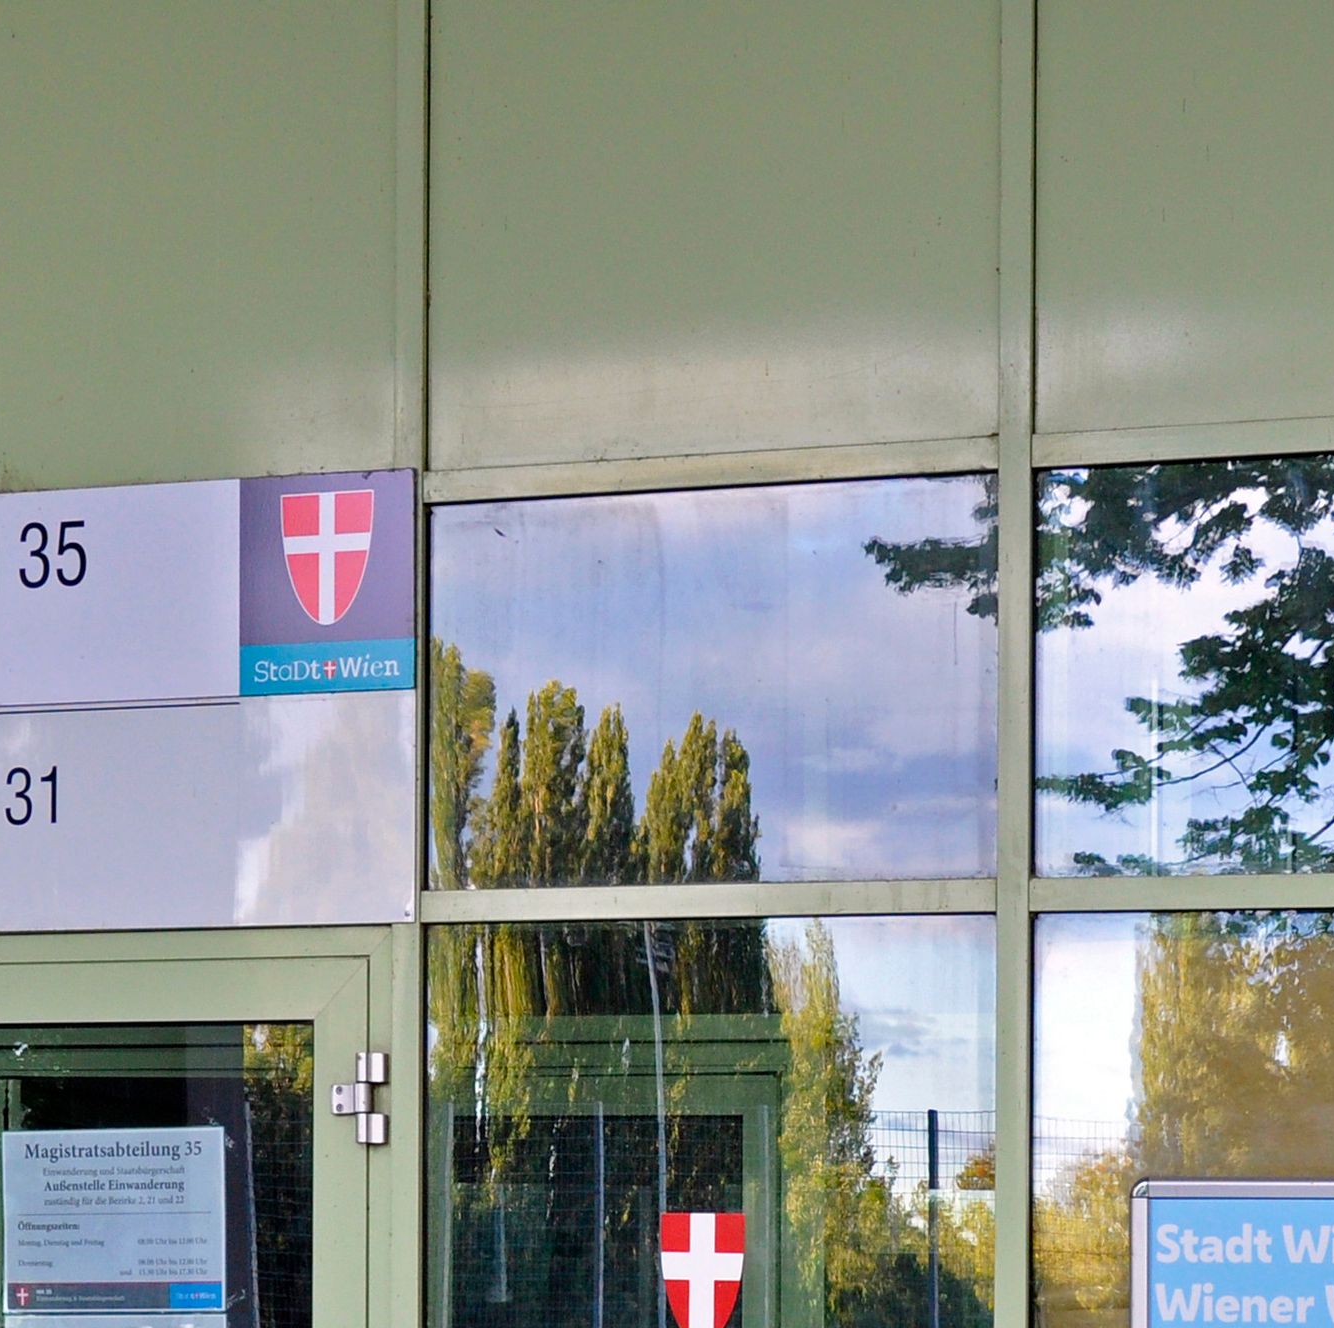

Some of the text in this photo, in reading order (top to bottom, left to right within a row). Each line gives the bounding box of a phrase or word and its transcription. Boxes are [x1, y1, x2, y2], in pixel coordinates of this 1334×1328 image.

[17, 520, 88, 589] 35
[338, 654, 400, 677] Wien
[4, 767, 62, 827] 31
[25, 1141, 202, 1163] Magistratsabteilung 35
[43, 1167, 97, 1177] Einwanderung
[100, 1167, 115, 1175] und
[44, 1180, 184, 1191] Außenstelle Einwanderung
[44, 1197, 80, 1207] zuständig
[82, 1196, 92, 1205] für
[95, 1196, 107, 1205] die
[158, 1196, 173, 1204] und
[18, 1221, 80, 1232] Öffnungszeiten:
[1156, 1223, 1272, 1263] Stadt
[1155, 1283, 1315, 1323] Wiener
